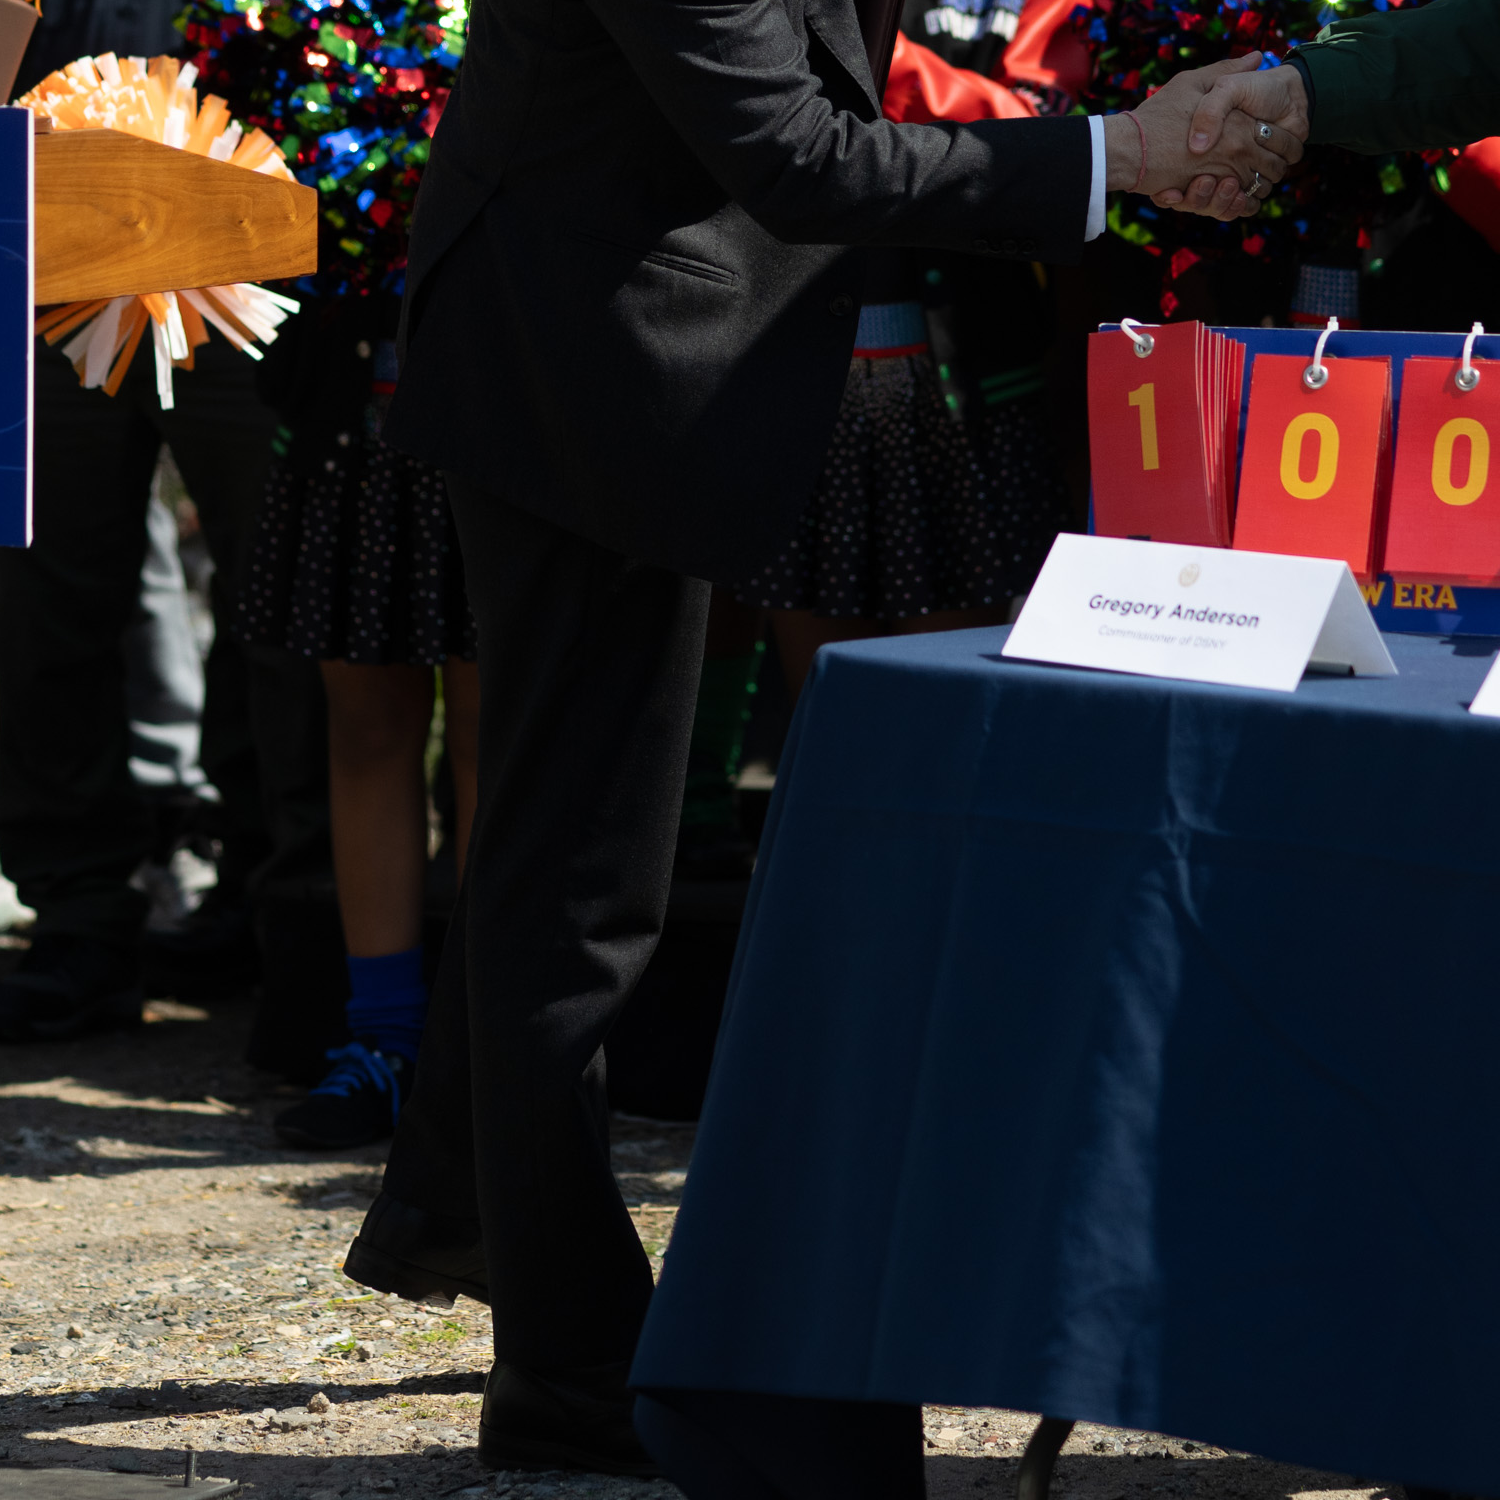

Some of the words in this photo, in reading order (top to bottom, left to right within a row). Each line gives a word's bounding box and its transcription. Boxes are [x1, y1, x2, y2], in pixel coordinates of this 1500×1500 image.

[1393, 583, 1458, 610] ERA
[1088, 594, 1165, 620] Gregory
[1168, 603, 1260, 628] Anderson
[1098, 624, 1177, 644] Commissioner
